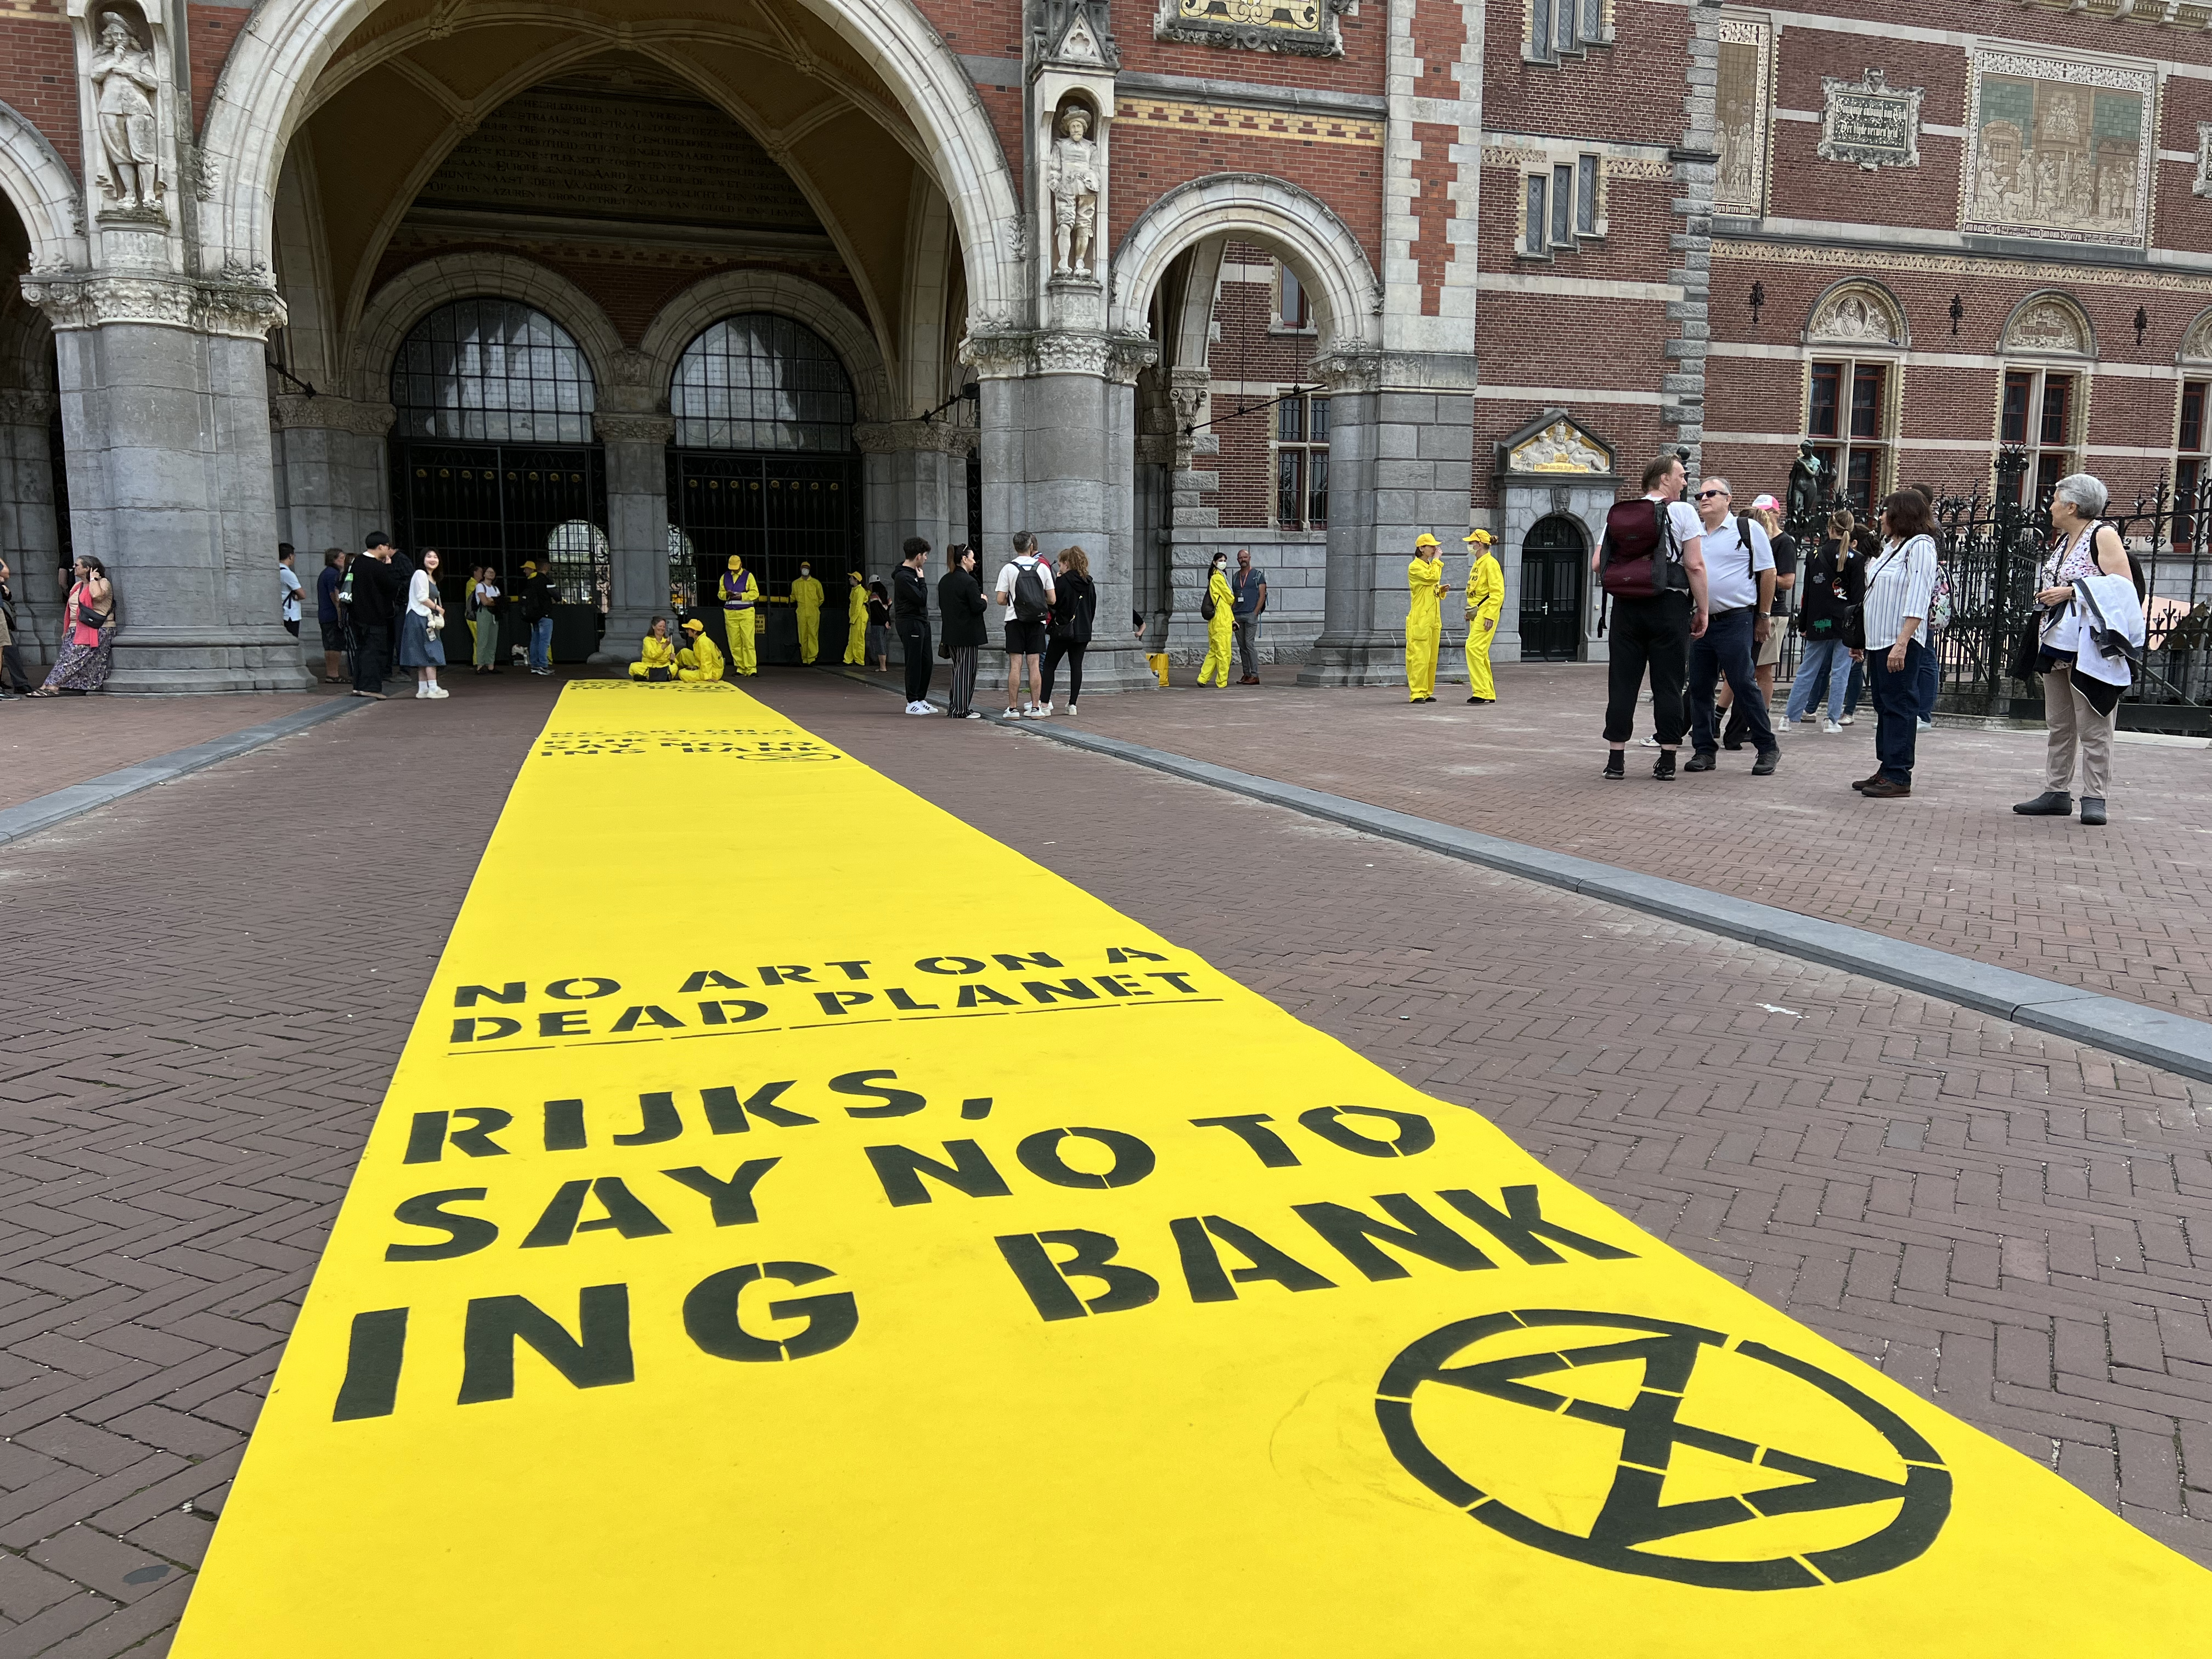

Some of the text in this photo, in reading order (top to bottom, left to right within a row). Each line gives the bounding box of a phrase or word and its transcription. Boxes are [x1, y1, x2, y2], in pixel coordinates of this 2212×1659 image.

[450, 973, 1198, 1043] DEAD PLANET
[455, 947, 1169, 1007] NO ART ON A
[403, 1070, 992, 1164] RIJKS,
[385, 1105, 1435, 1261] SAY NO TO
[332, 1185, 1640, 1422] ING BANK
